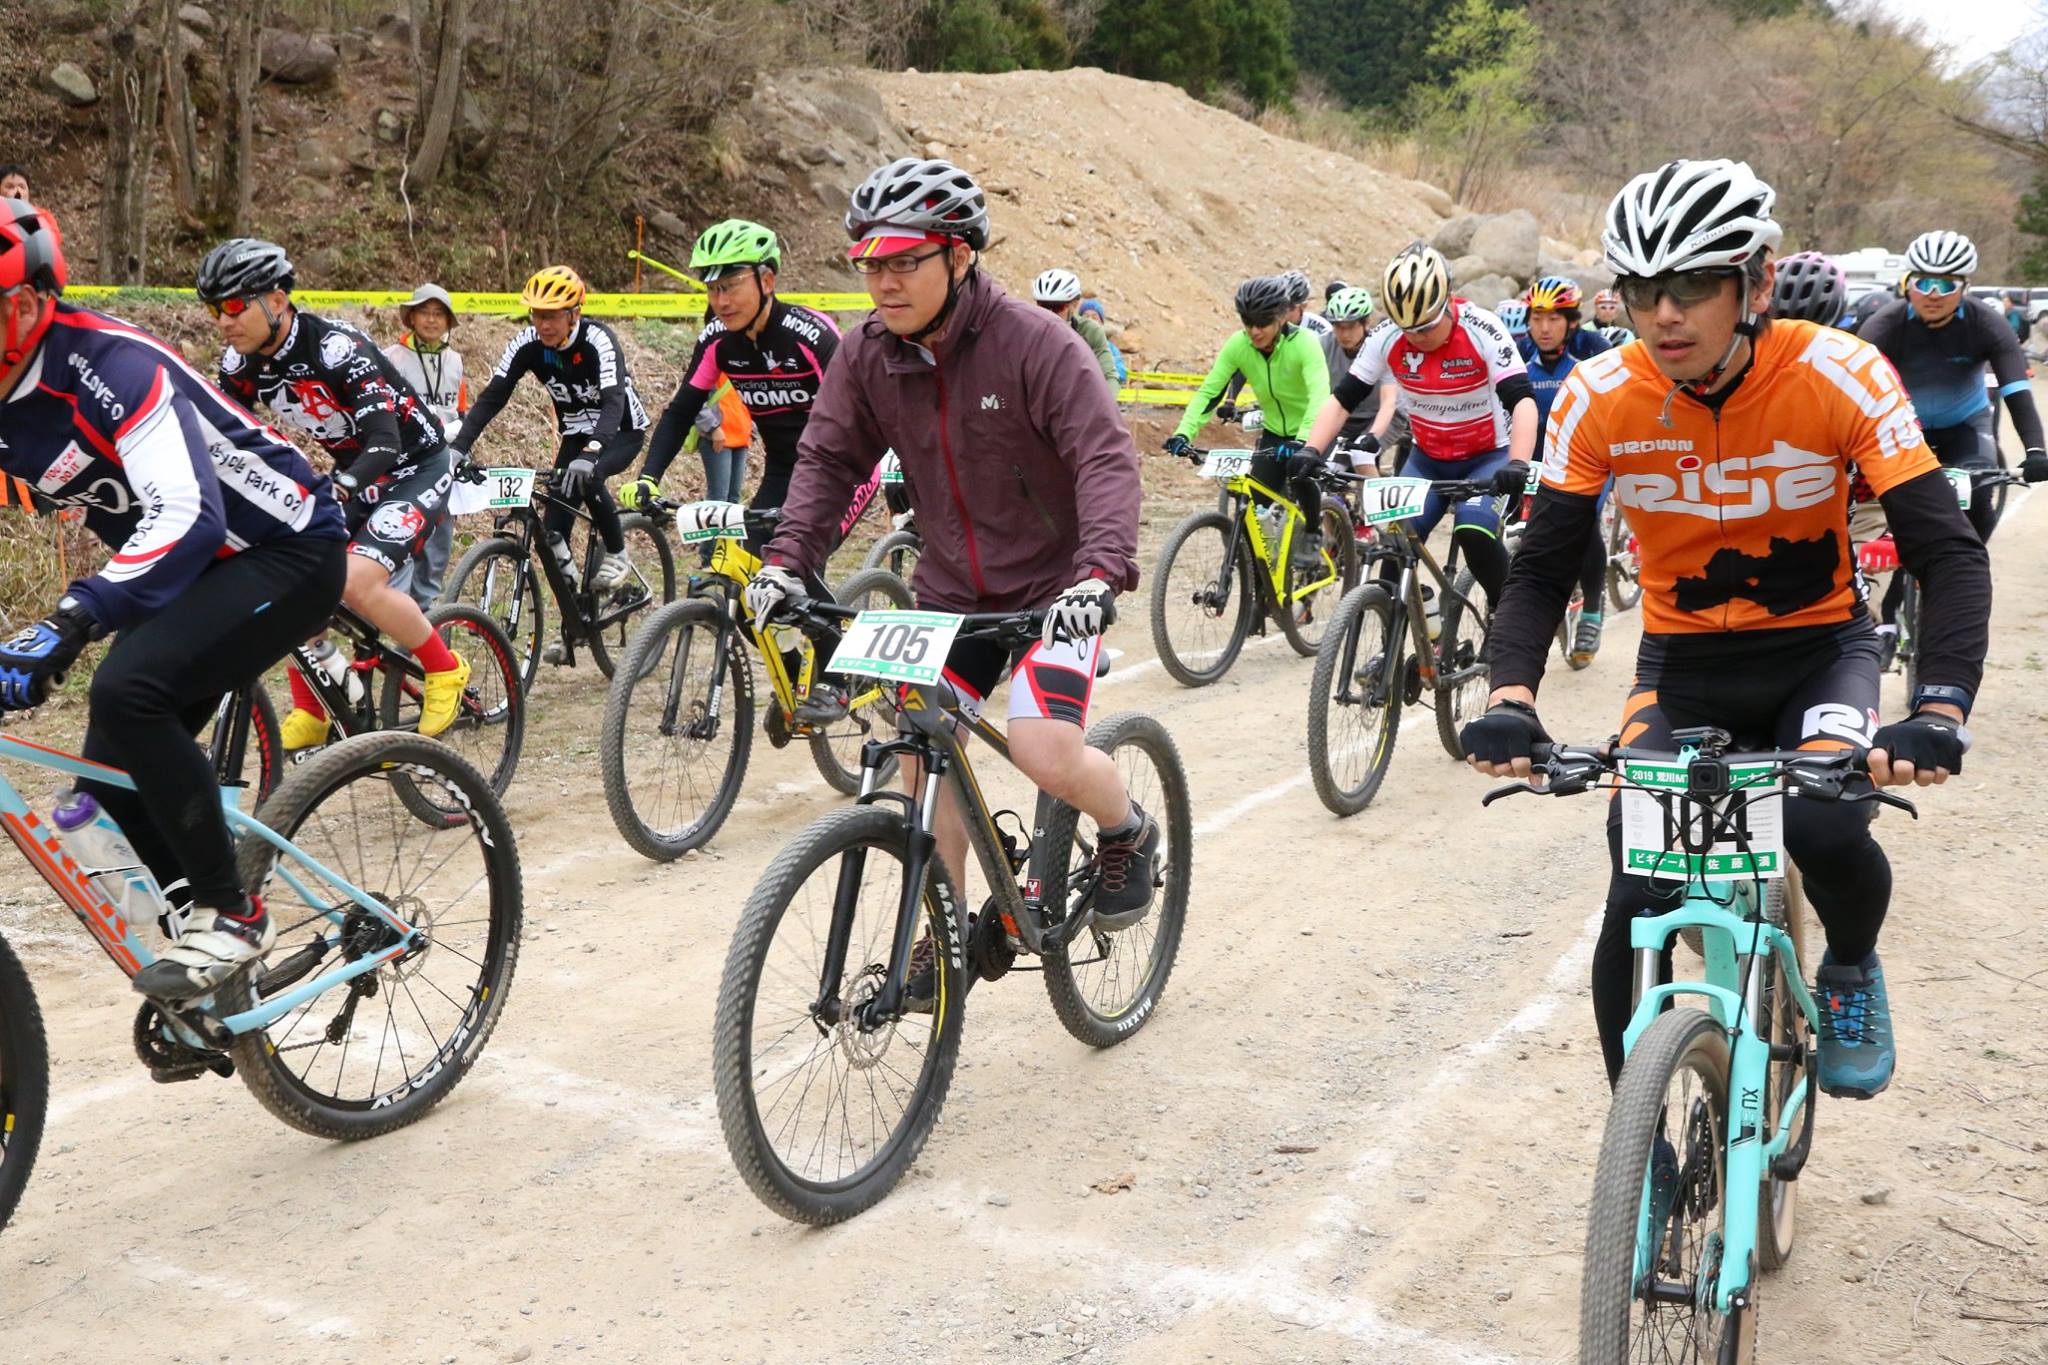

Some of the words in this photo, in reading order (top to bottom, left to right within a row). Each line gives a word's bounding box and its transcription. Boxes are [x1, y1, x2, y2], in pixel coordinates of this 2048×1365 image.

[1608, 439, 1694, 457] BROWN
[1216, 456, 1242, 472] 129
[244, 468, 280, 500] park
[498, 476, 524, 498] 132
[1378, 485, 1417, 511] 107
[694, 504, 733, 530] 127
[863, 624, 936, 665] 105
[1632, 770, 1654, 782] 2019
[1655, 787, 1754, 855] 104
[935, 882, 962, 970] MAXXIS
[1116, 996, 1153, 1032] MAXXIS
